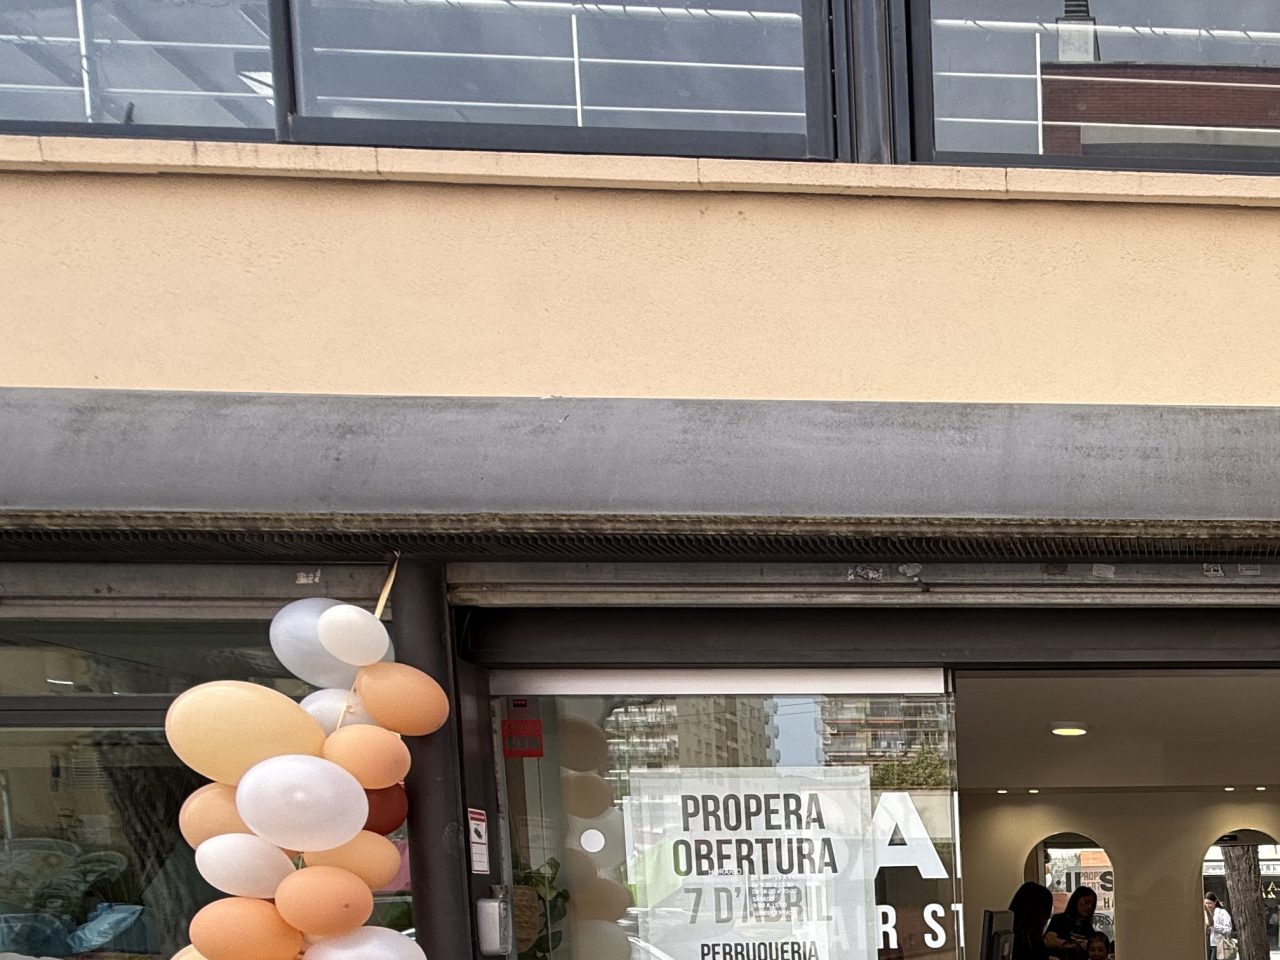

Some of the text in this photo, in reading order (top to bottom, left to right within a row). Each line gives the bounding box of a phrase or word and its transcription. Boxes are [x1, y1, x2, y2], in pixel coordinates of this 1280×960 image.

[681, 793, 825, 832] PROPERA
[672, 837, 838, 877] OBERTURA
[684, 885, 832, 925] 7 D'ABRIL
